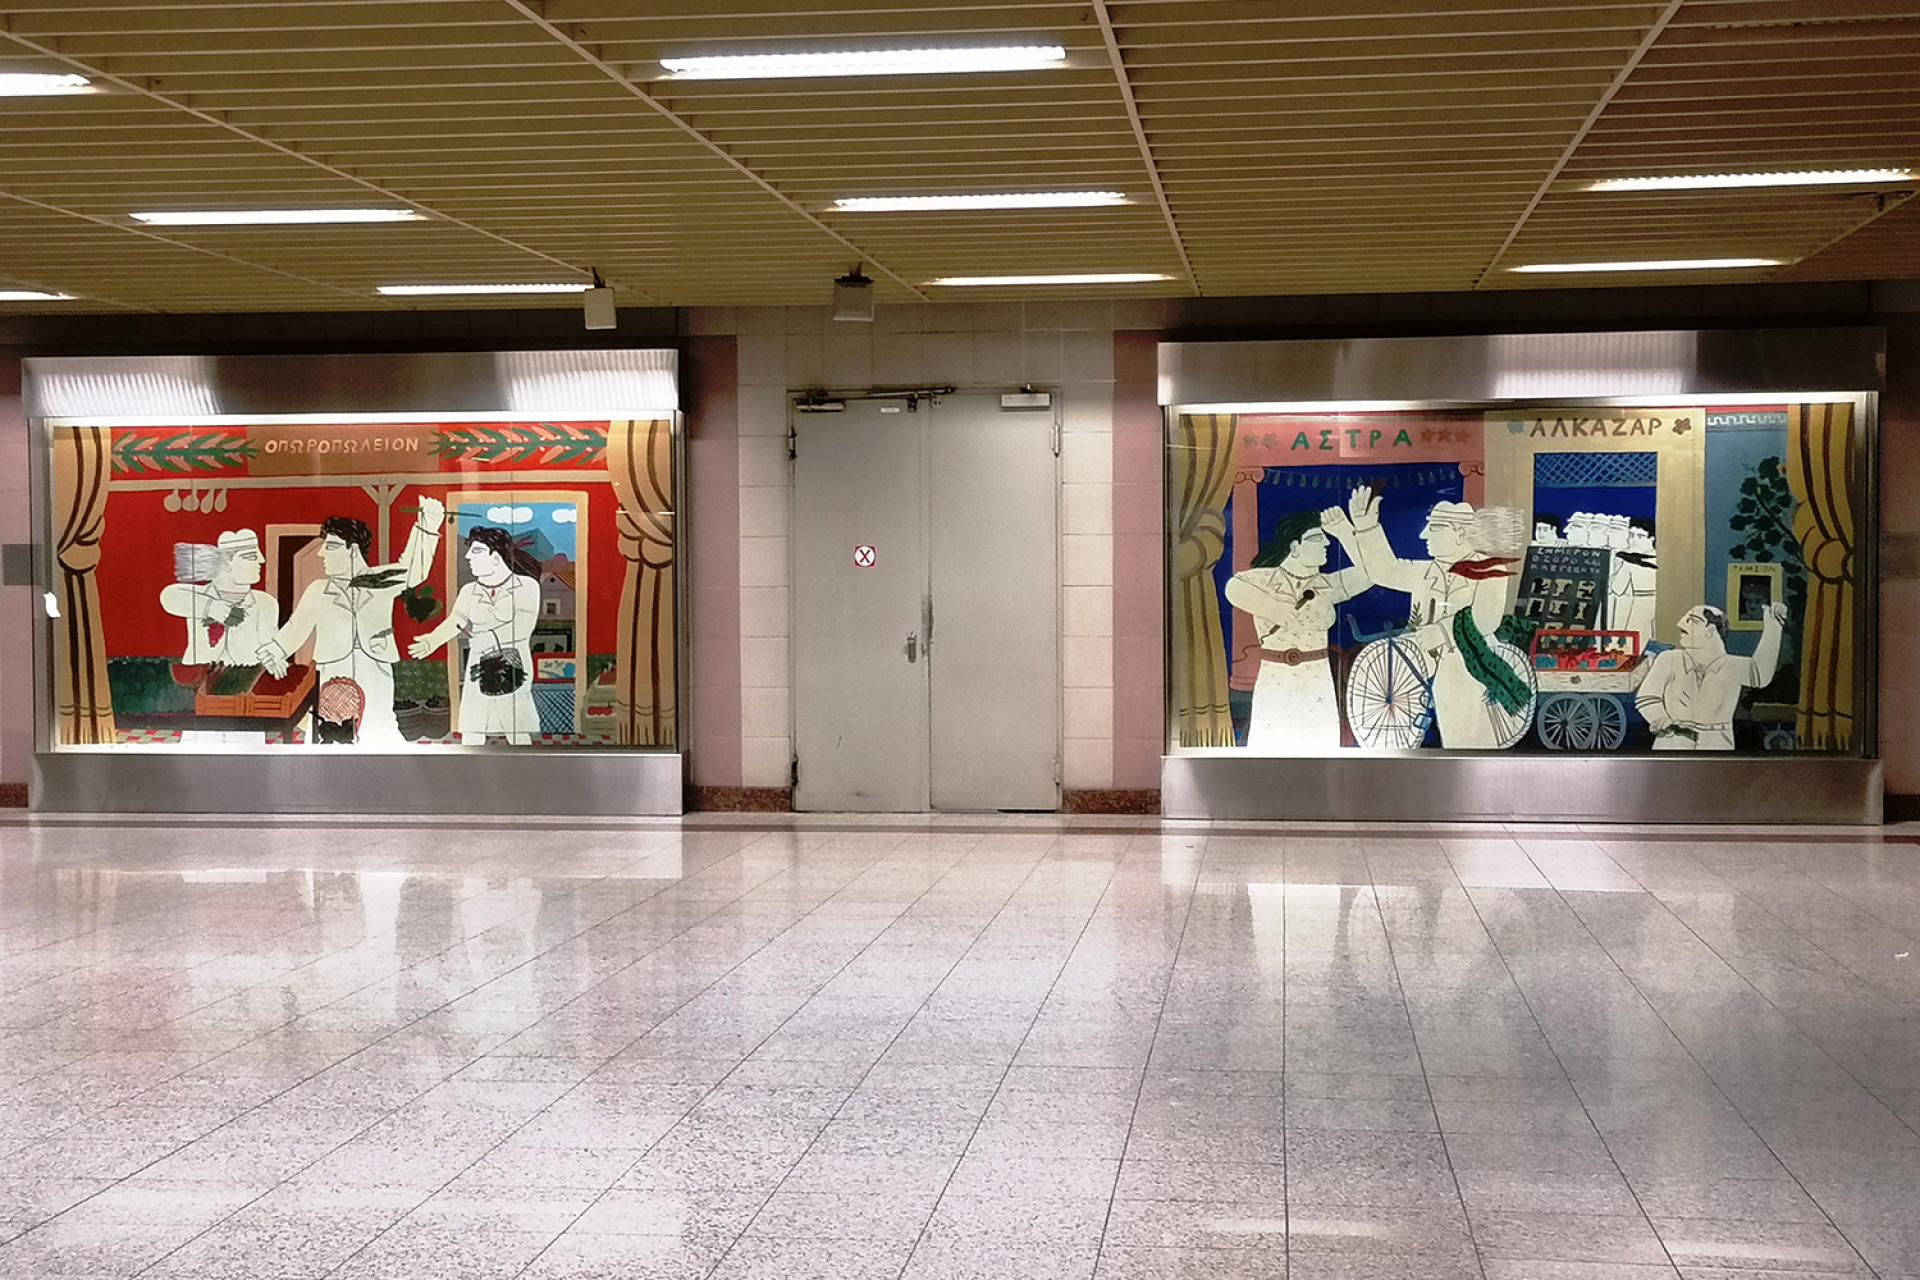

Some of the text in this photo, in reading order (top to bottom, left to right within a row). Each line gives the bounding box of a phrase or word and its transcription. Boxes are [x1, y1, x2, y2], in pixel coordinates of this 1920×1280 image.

[1530, 417, 1662, 437] ΑΛΚΑΖΑΡ
[265, 438, 419, 453] ΟΠΩΡΟΠΩΛΕΙΟΝ
[1290, 429, 1412, 450] ΑΣΤΡΑ
